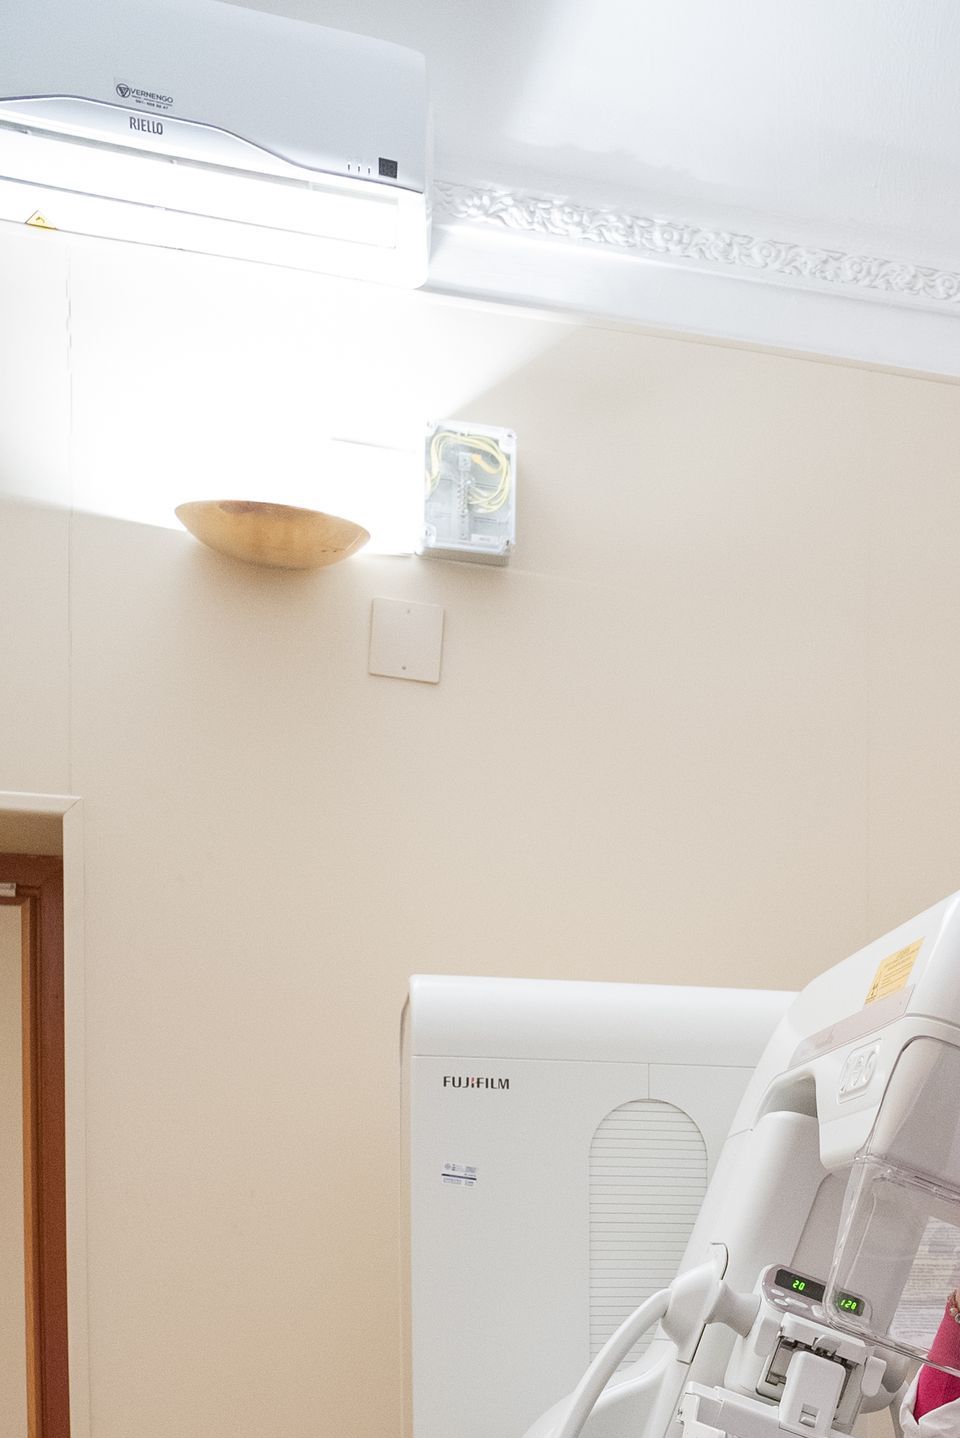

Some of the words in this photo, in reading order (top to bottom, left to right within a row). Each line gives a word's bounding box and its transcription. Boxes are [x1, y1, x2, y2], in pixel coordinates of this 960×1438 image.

[130, 88, 174, 103] VERNENGO
[129, 116, 163, 135] RIELLO
[443, 1075, 510, 1090] FUJIFILM
[792, 1280, 806, 1291] 20
